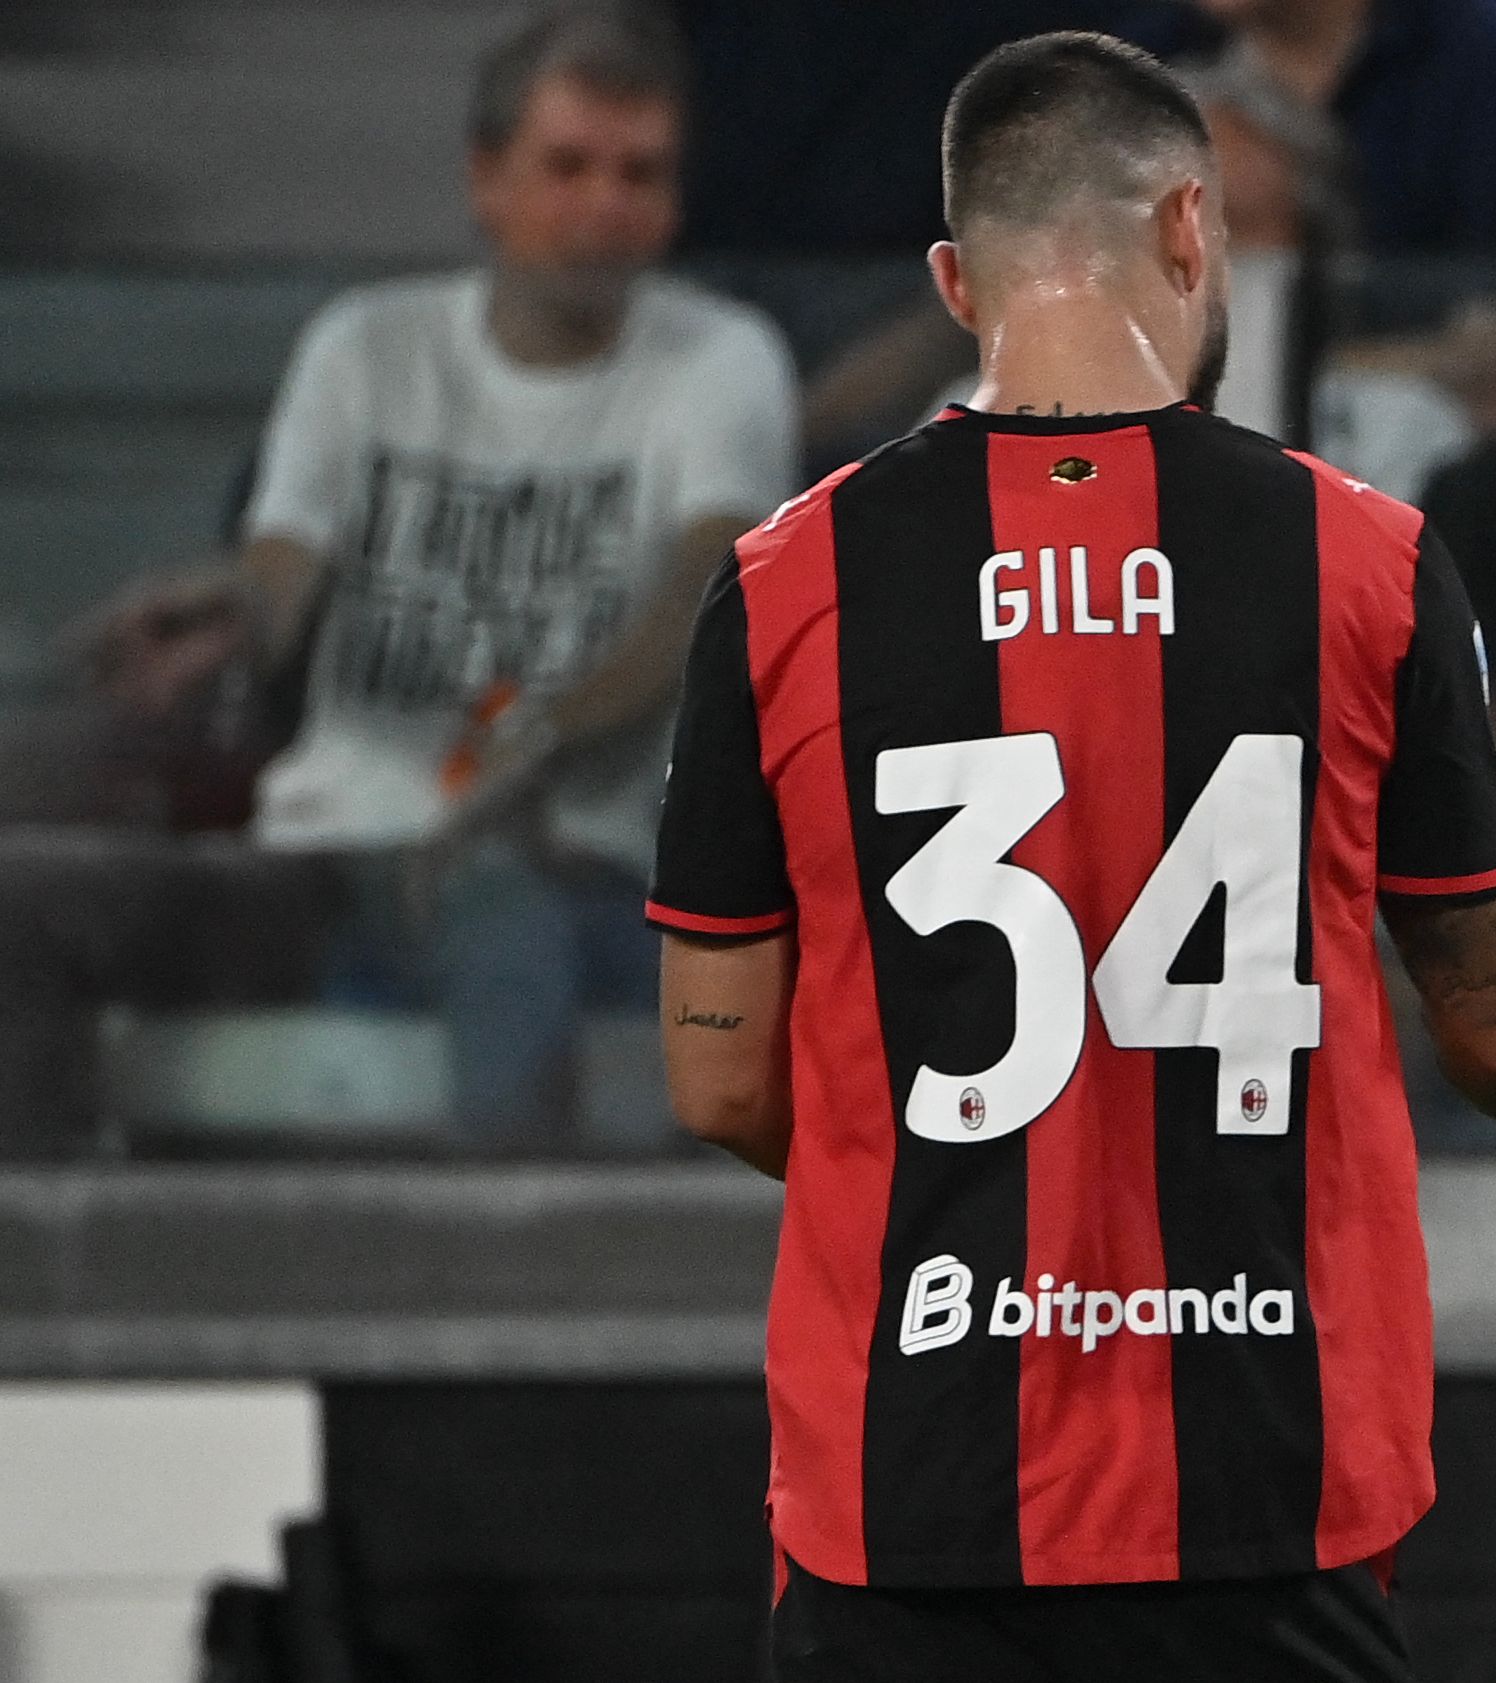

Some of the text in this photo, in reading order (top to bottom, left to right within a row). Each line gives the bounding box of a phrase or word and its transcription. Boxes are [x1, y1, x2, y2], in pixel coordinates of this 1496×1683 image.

[978, 546, 1175, 642] GILA
[875, 731, 1321, 1143] 34
[988, 1272, 1295, 1354] bitpanda
